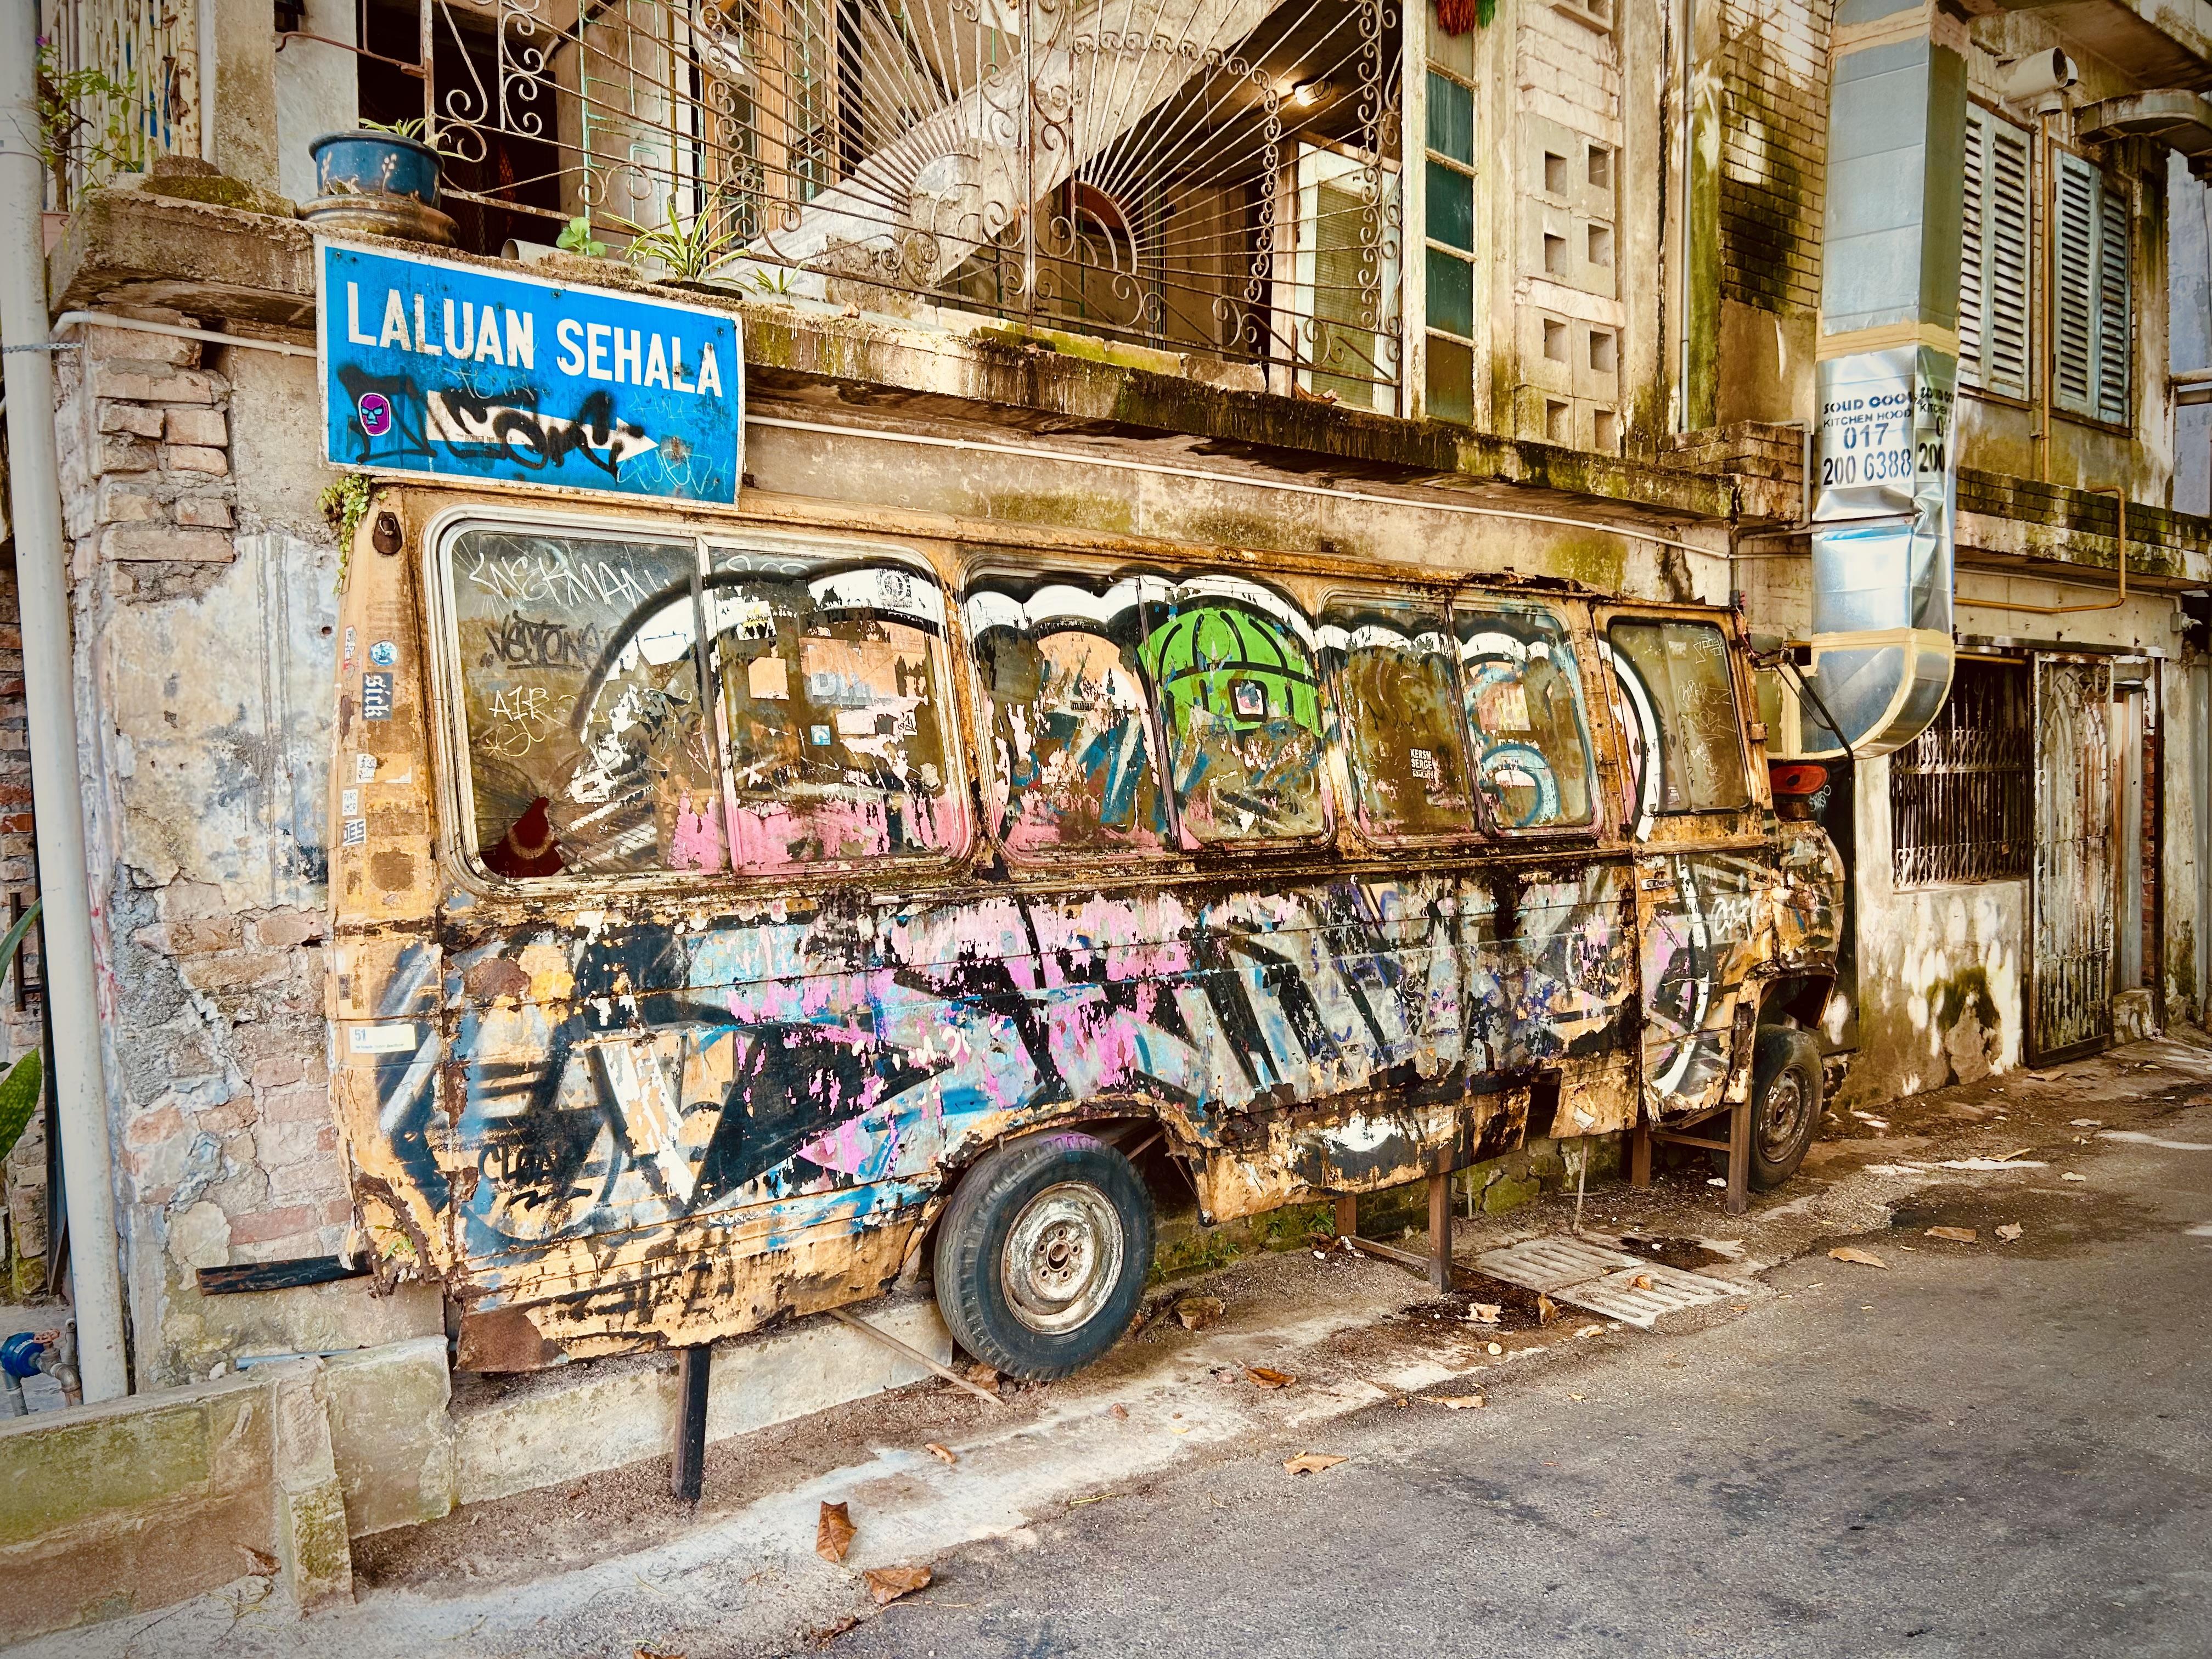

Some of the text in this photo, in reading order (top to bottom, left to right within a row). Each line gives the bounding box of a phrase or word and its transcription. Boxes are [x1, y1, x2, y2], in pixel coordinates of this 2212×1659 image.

[347, 282, 723, 398] LALUAN SEHALA
[1823, 408, 1912, 429] KITCHEN HOOD
[1843, 423, 1889, 450] 017
[1823, 448, 1912, 486] 200 6388
[1918, 442, 1945, 473] 200
[1411, 758, 1432, 769] SERGE
[354, 1028, 367, 1041] 51
